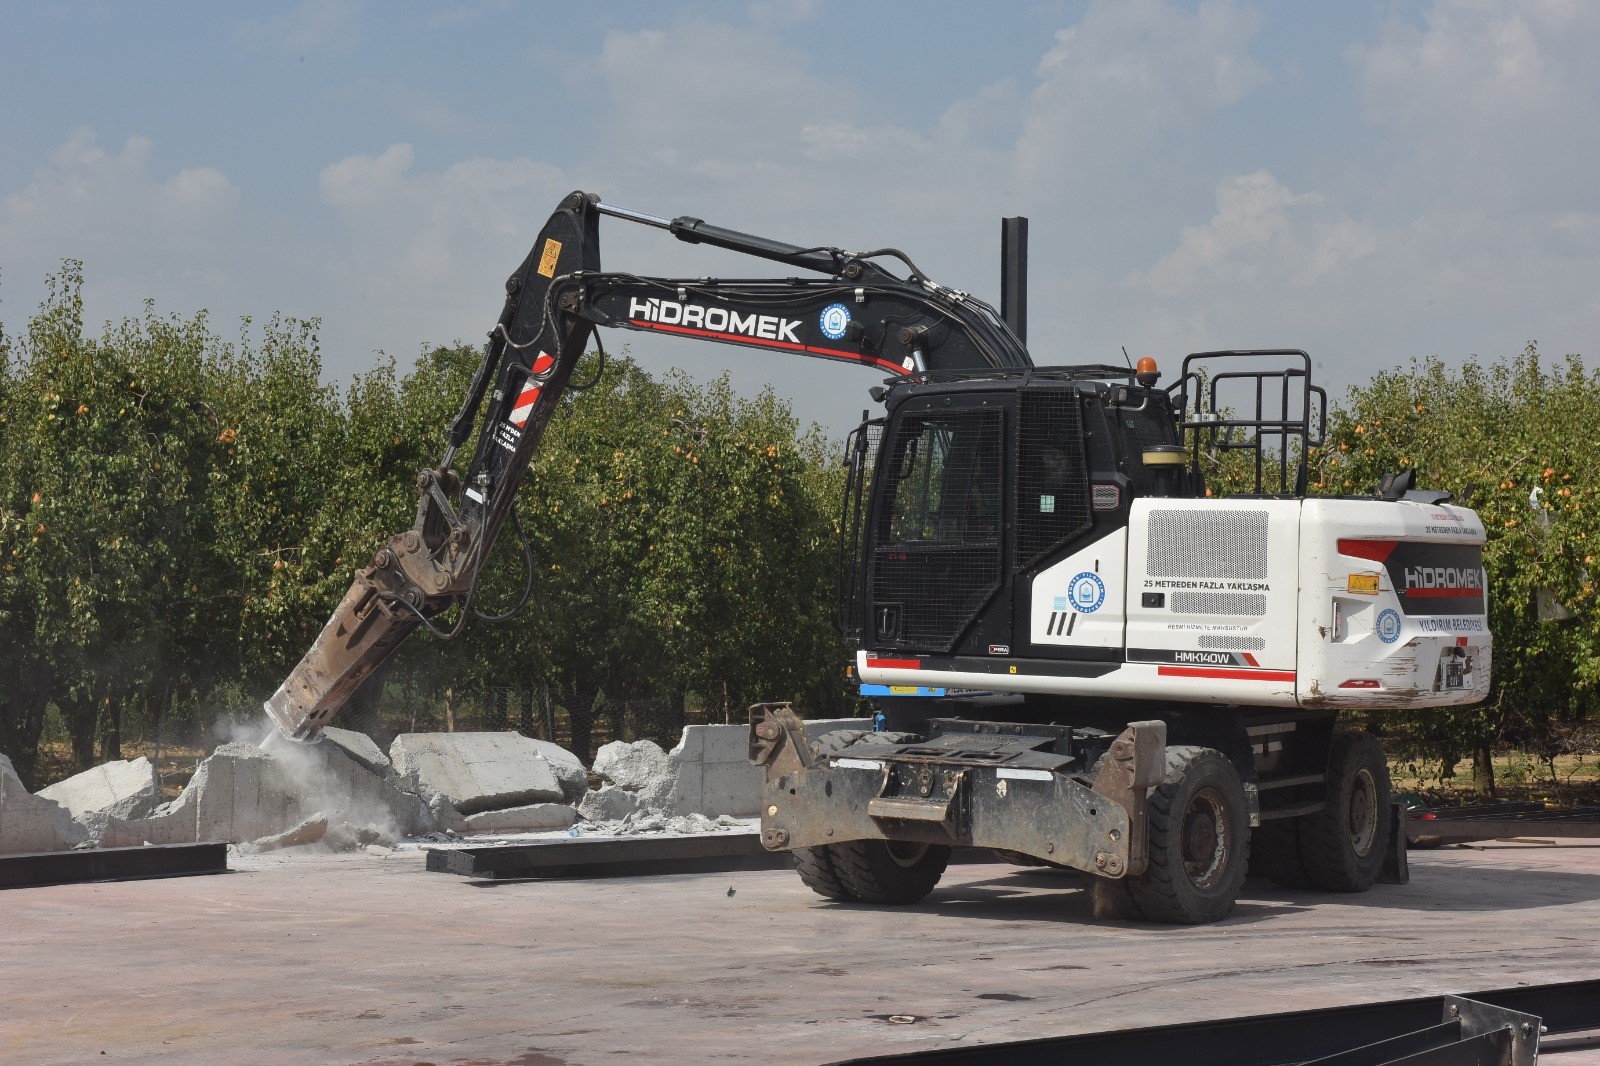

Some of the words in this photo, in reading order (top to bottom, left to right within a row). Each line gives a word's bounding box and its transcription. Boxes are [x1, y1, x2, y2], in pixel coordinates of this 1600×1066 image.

[499, 430, 515, 443] FAZLA
[1143, 580, 1154, 588] 25
[1154, 580, 1198, 589] METREDEN
[1199, 581, 1225, 590] FAZLA
[1226, 582, 1271, 592] YAKLAŞMA
[1419, 619, 1453, 632] YILDIRIM
[1174, 651, 1230, 664] HMK140W
